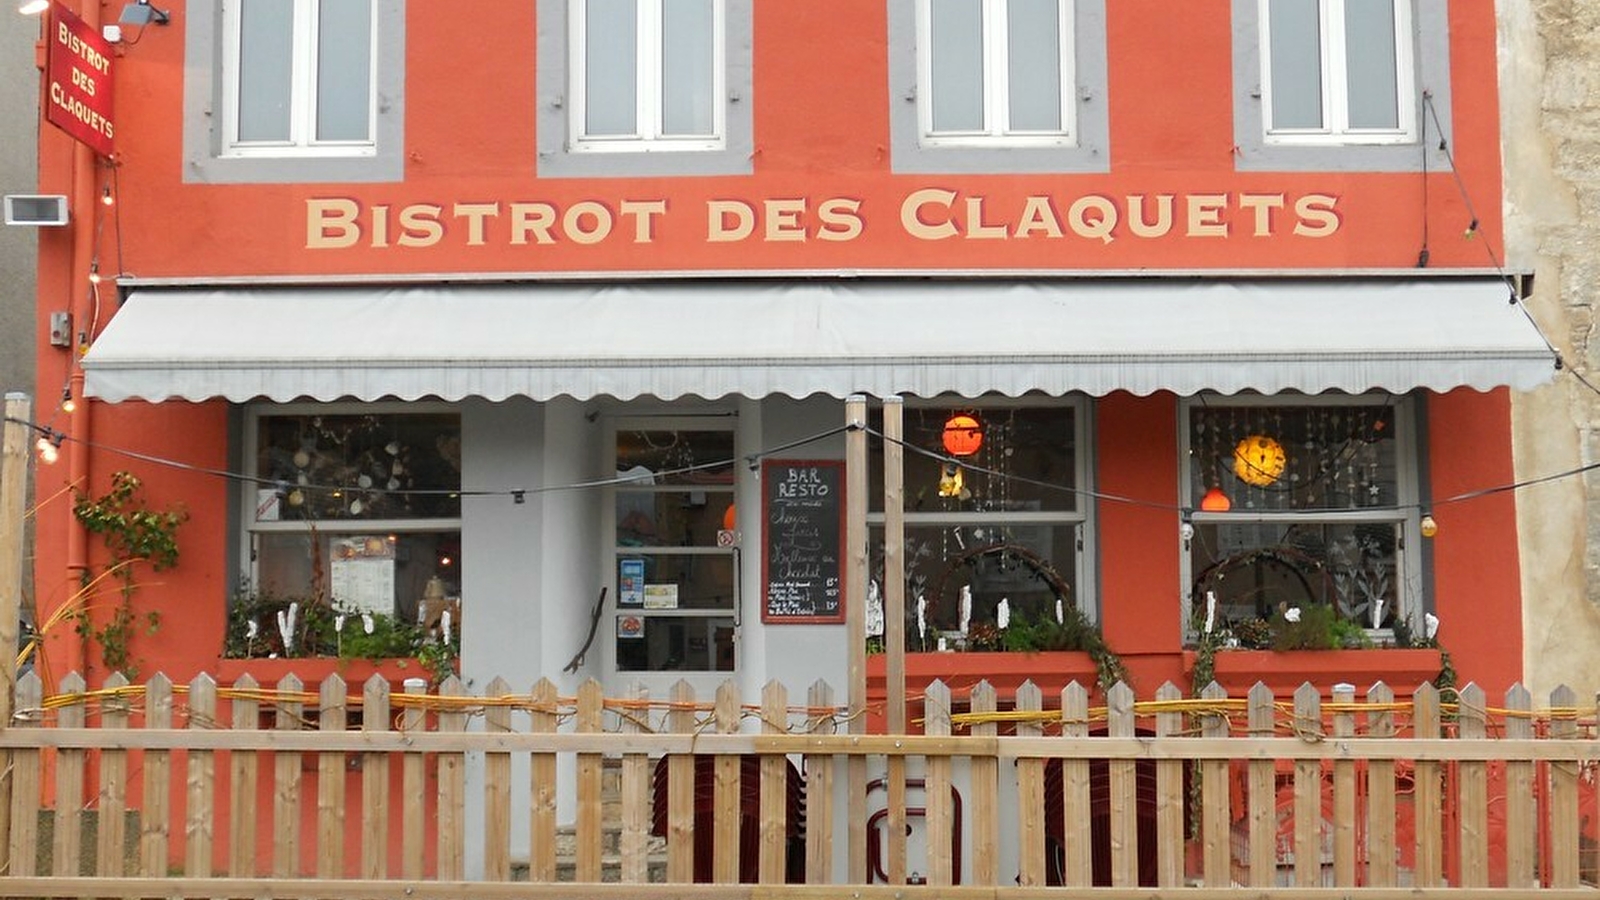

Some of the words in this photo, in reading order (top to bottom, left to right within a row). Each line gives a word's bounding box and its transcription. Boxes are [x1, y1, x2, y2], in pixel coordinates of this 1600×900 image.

[58, 21, 110, 75] BISTROT
[71, 66, 96, 97] DES
[50, 81, 114, 139] CLAQUETS
[305, 197, 668, 250] BISTROT
[706, 197, 863, 244] DES
[900, 188, 1342, 245] CLAQUETS
[779, 482, 829, 497] RESTO
[786, 467, 821, 483] BAR
